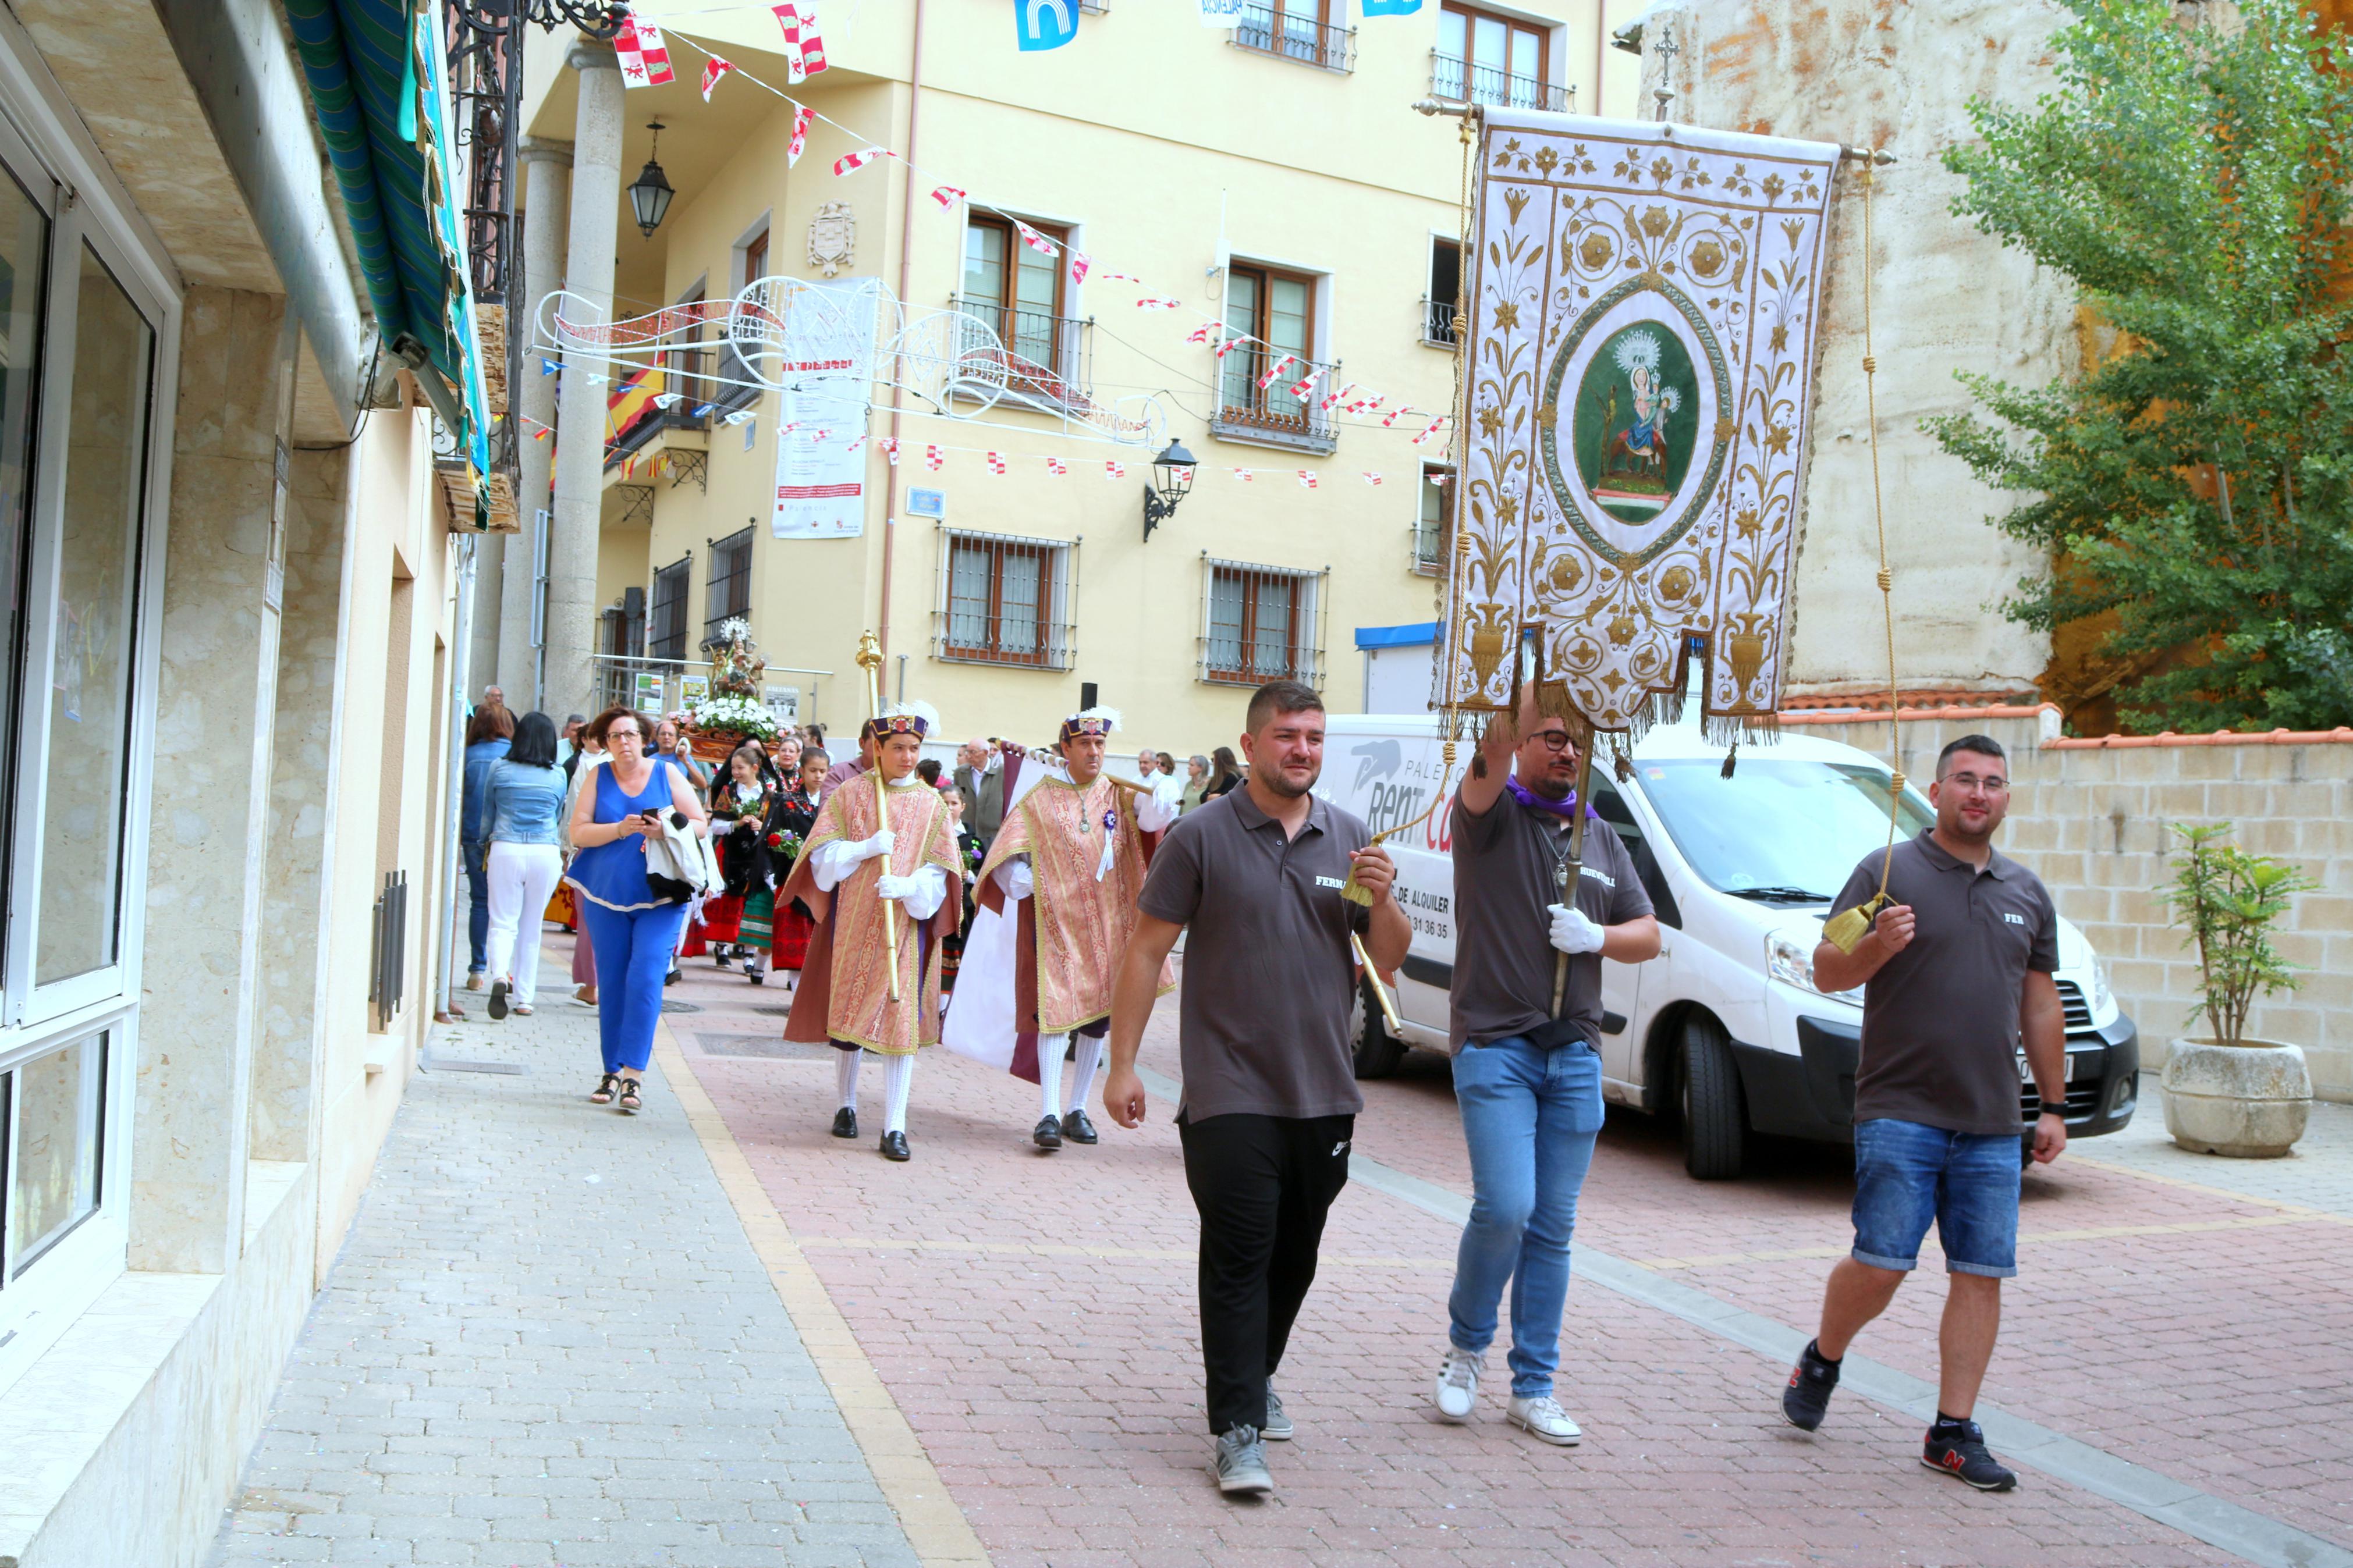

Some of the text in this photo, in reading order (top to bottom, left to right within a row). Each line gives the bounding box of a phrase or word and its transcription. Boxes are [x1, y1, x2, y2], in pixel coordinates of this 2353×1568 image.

[1398, 886, 1408, 904] DE
[1411, 890, 1449, 915] ALQUILER
[1412, 917, 1422, 932] 31
[1425, 920, 1435, 936] 36
[1437, 923, 1447, 938] 35
